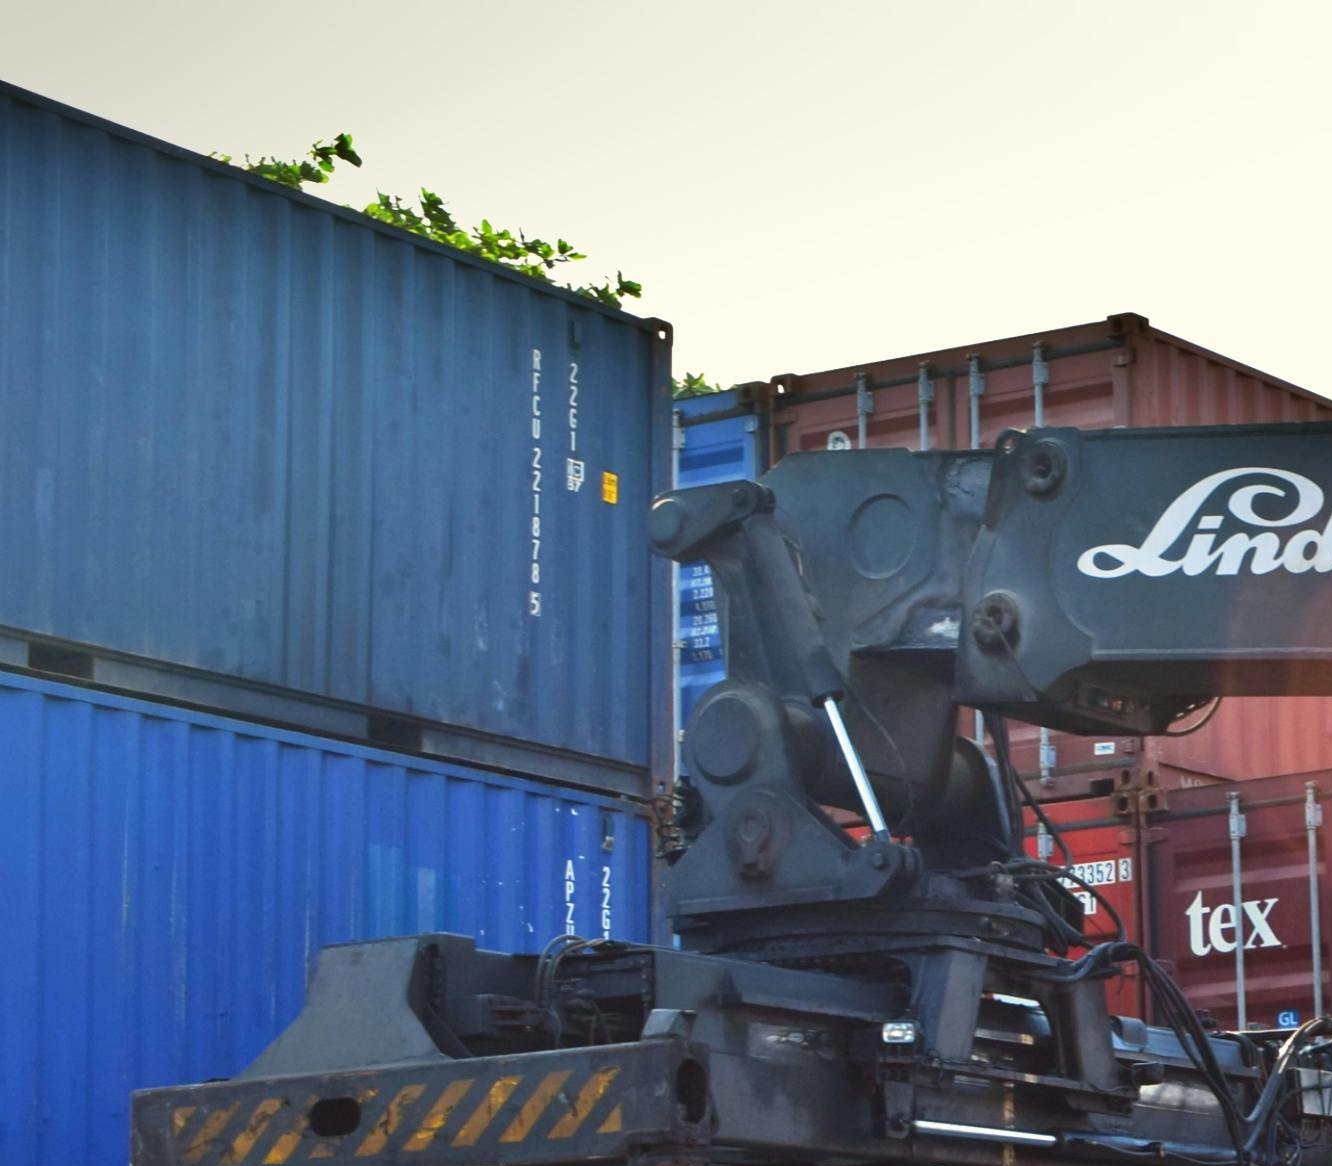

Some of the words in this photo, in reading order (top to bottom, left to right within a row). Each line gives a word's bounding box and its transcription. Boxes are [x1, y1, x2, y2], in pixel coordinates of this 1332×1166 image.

[532, 447, 541, 584] 221878
[530, 591, 541, 616] 5
[1121, 860, 1129, 880] 3
[1185, 891, 1283, 956] tex
[1279, 1012, 1298, 1026] GL
